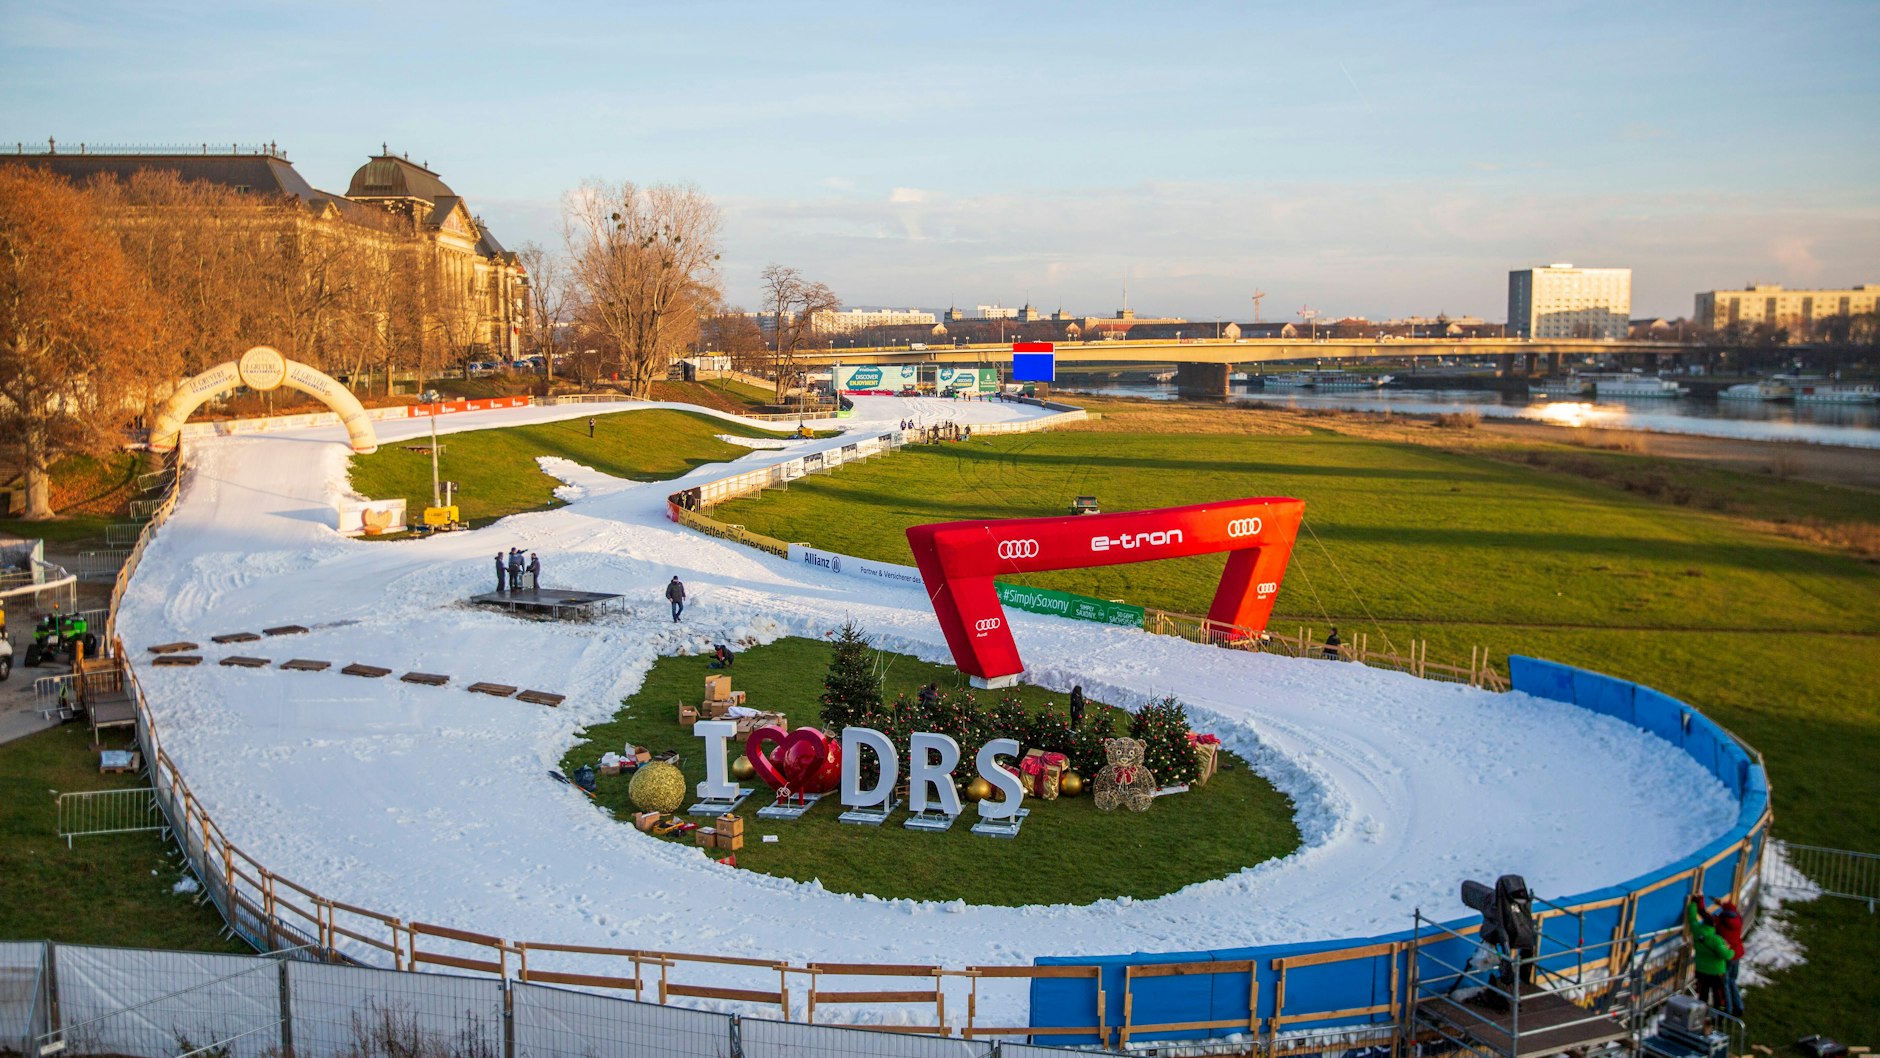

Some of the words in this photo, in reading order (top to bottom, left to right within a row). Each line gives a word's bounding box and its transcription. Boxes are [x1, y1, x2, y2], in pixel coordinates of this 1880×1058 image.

[686, 514, 726, 539] interwetten
[740, 533, 788, 560] interwetten
[1091, 529, 1183, 552] e-tron
[804, 552, 830, 569] Allianz
[860, 566, 878, 576] Partner
[883, 570, 912, 582] Versicherer
[912, 575, 921, 584] des
[1003, 588, 1070, 613] #SimplySaxony
[694, 720, 740, 798] I
[841, 727, 1024, 818] DRS
